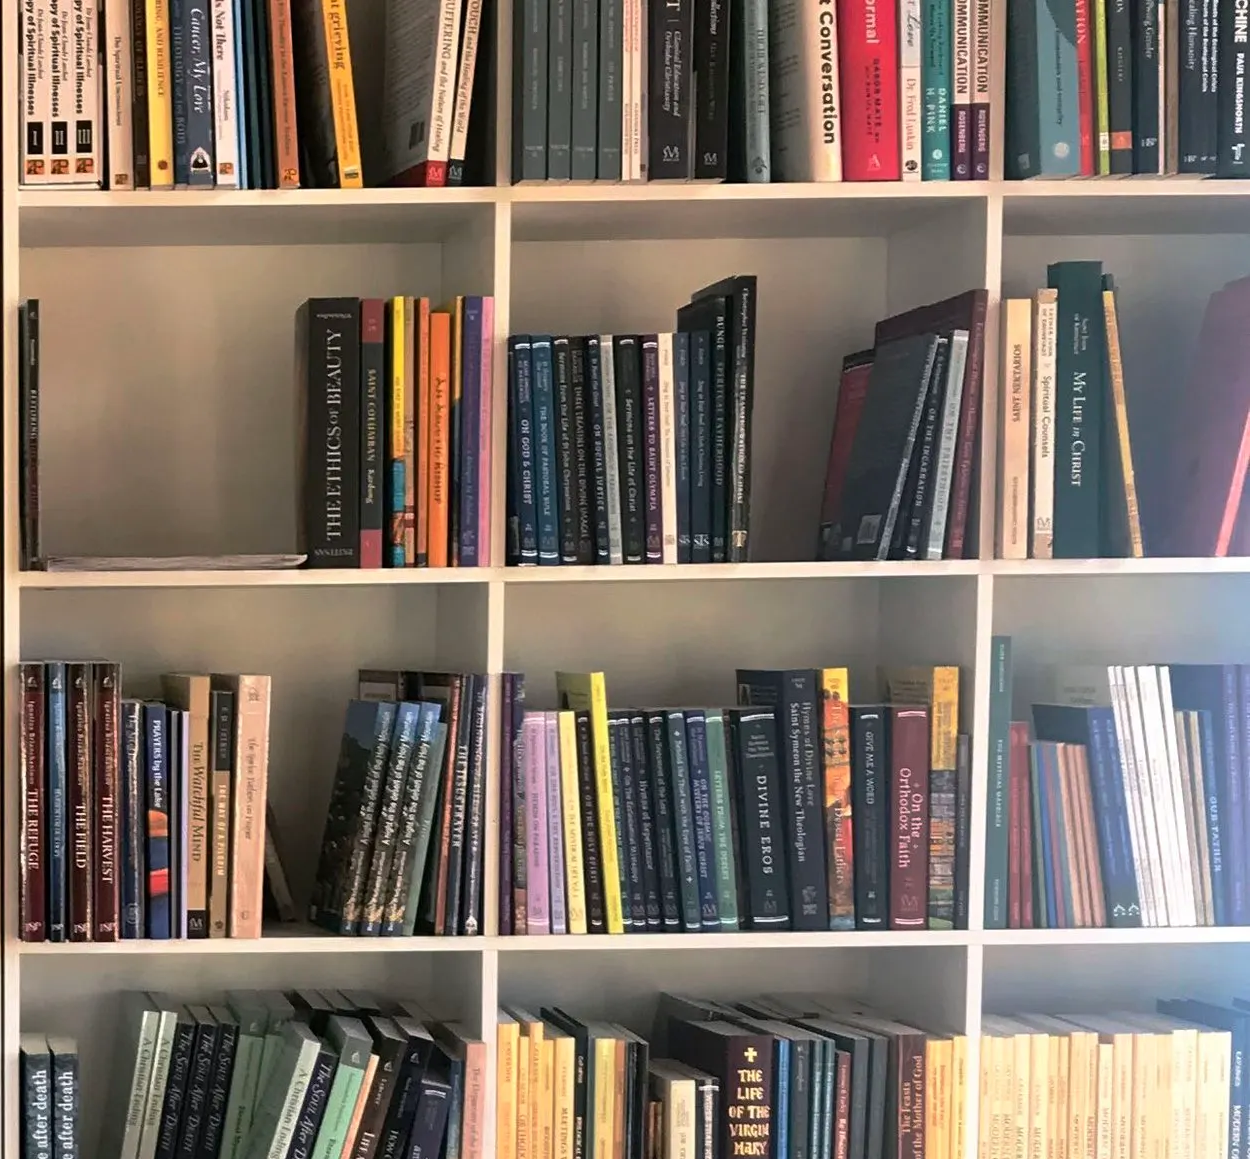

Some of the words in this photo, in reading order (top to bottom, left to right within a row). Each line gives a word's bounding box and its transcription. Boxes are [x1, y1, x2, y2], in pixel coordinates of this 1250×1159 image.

[75, 14, 83, 24] of
[190, 8, 205, 54] Cancer,
[76, 26, 84, 69] Spiritual
[329, 13, 346, 70] grieving
[192, 57, 206, 80] My
[820, 11, 836, 143] Conversation
[76, 72, 84, 114] Illnesses
[193, 85, 207, 113] Love
[936, 88, 947, 132] DANIEL
[957, 110, 967, 153] ROSENBERG
[977, 109, 986, 152] ROSENBERG
[326, 329, 342, 405] BEAUTY
[1041, 376, 1051, 413] Spiritual
[1073, 397, 1085, 424] LIFE
[522, 437, 531, 457] GOD
[1041, 417, 1050, 458] Counsels
[1073, 427, 1081, 437] in
[326, 427, 341, 501] ETHICS
[1071, 441, 1084, 487] CHRIST
[523, 471, 532, 504] CHRIST
[326, 503, 341, 540] THE
[152, 720, 162, 759] PRAYERS
[193, 742, 203, 765] THE
[152, 761, 162, 771] by
[154, 773, 162, 786] the
[28, 789, 38, 816] THE
[101, 794, 113, 822] THE
[154, 788, 162, 807] Lake
[192, 766, 205, 821] Watchful
[756, 776, 768, 828] DIVINE
[899, 768, 910, 830] Orthodox
[912, 794, 922, 812] On
[75, 803, 86, 829] THE
[912, 817, 922, 838] the
[28, 820, 39, 869] REFUGE
[75, 833, 86, 868] FIELD
[101, 825, 113, 883] HARVEST
[761, 836, 773, 874] EROS
[899, 835, 910, 868] Faith
[60, 1071, 75, 1111] death
[738, 1069, 762, 1082] THE
[737, 1087, 763, 1100] LIFE
[750, 1106, 771, 1118] THE
[59, 1115, 74, 1149] after
[730, 1124, 769, 1137] VIRGIN
